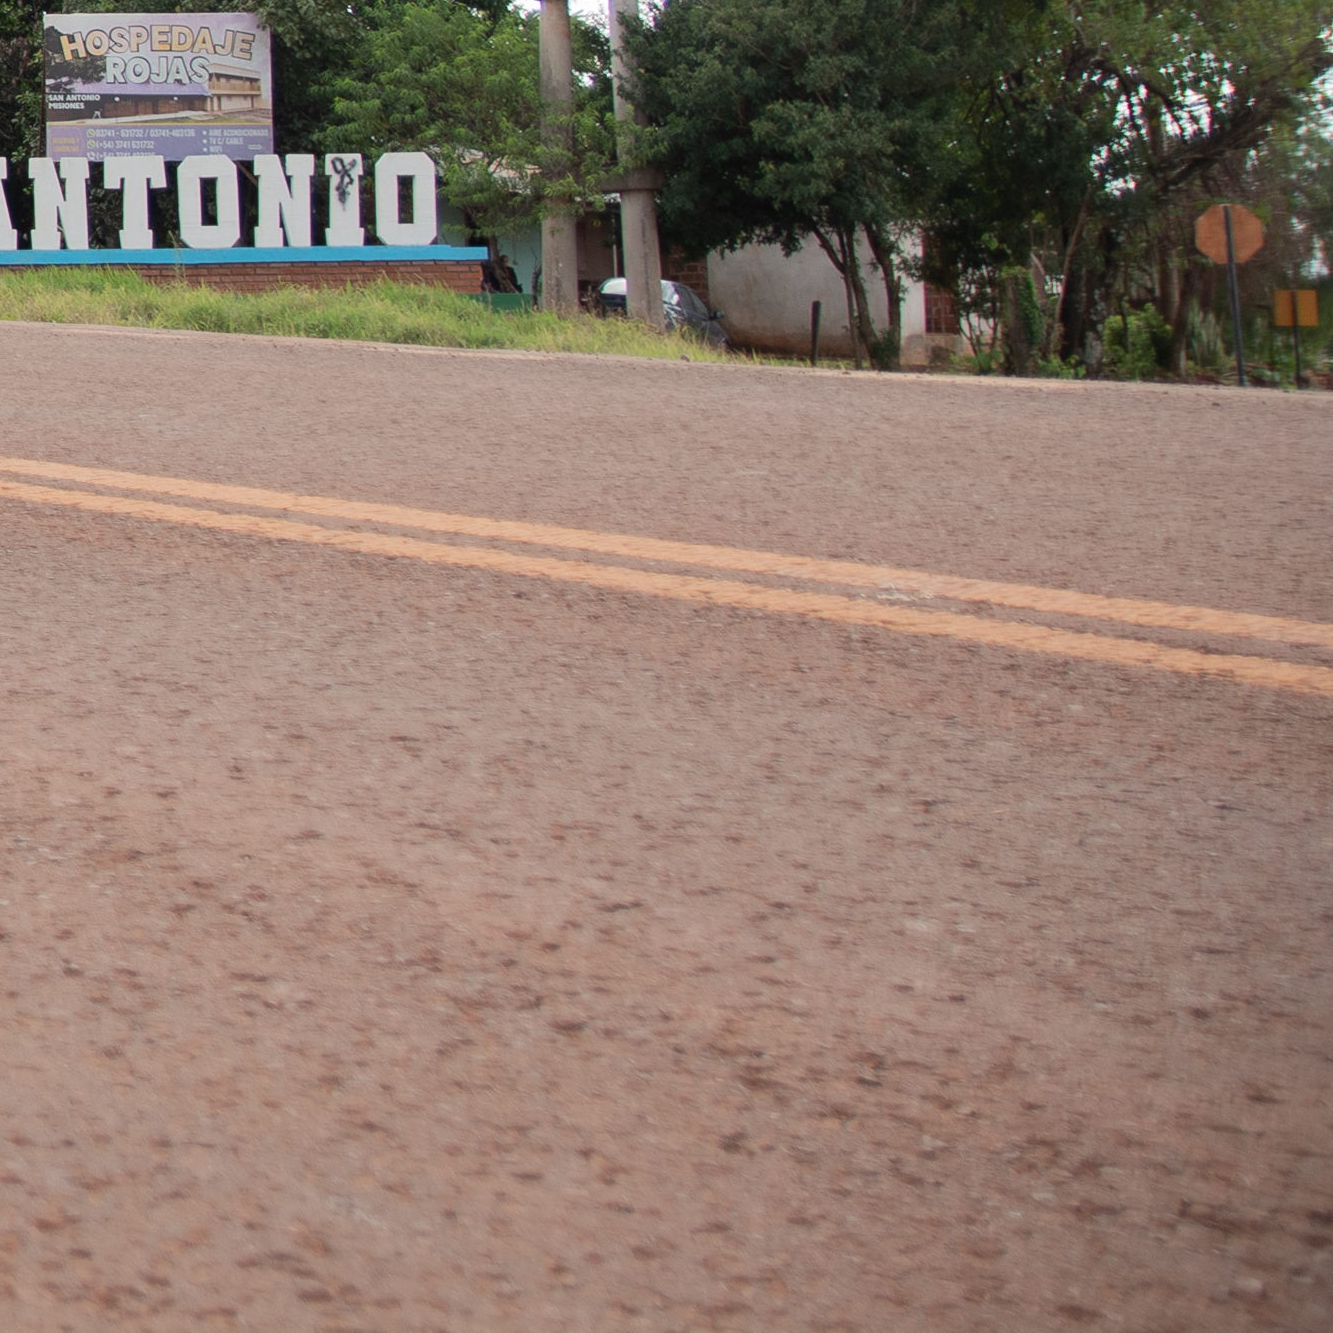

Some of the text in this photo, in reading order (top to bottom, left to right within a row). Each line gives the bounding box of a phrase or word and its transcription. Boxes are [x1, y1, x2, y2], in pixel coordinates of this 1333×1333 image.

[60, 24, 256, 61] HOSPEDAJE
[105, 56, 211, 85] ROJAS
[48, 94, 101, 102] SAN ANTONIO
[48, 102, 85, 110] MISIONES
